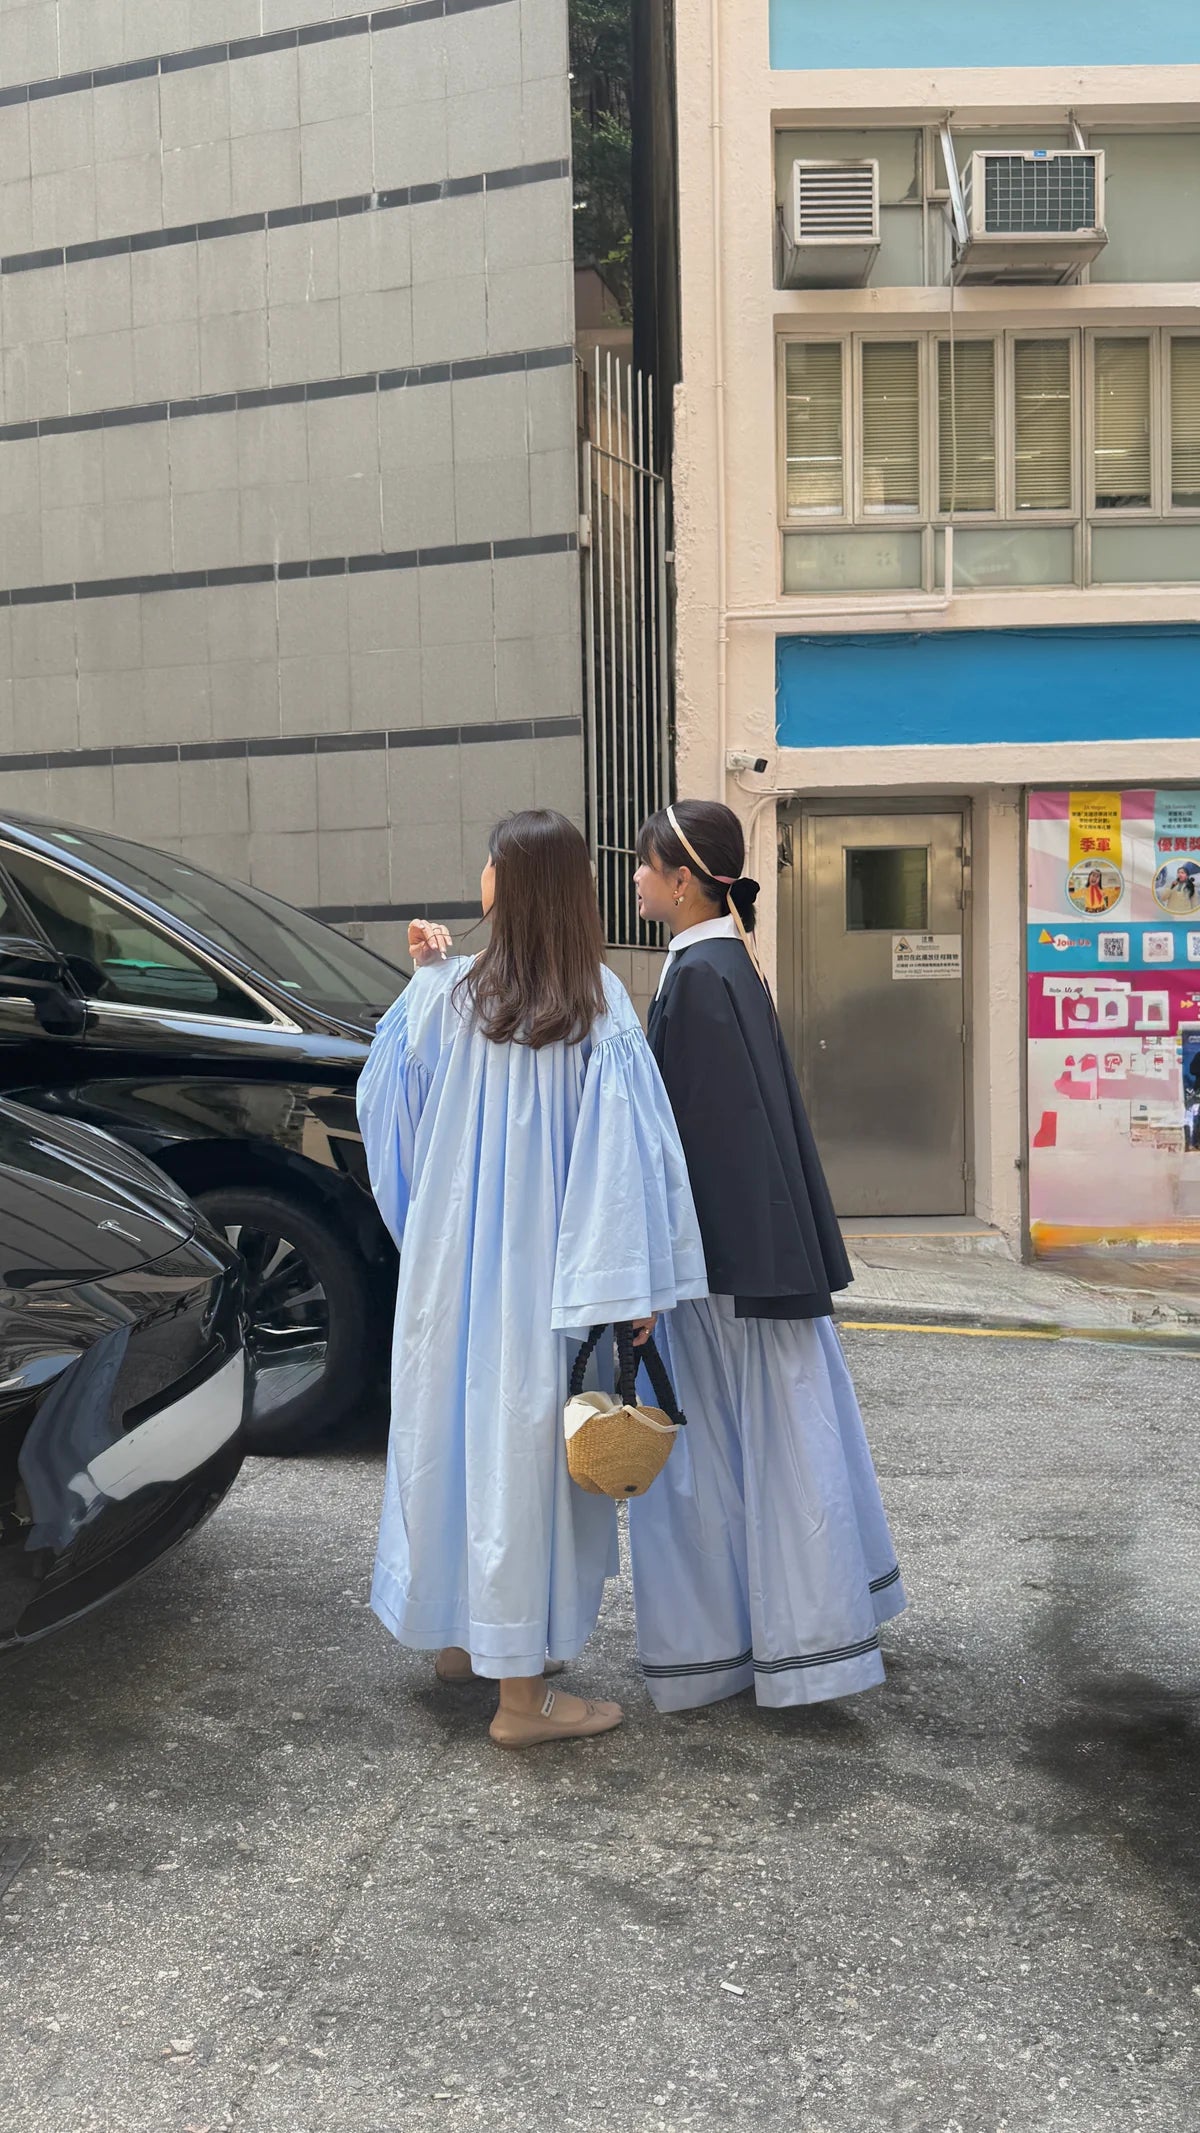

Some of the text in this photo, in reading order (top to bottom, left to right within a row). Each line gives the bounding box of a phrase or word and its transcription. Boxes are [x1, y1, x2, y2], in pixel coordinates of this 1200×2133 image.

[1079, 837, 1111, 853] 季軍
[1056, 938, 1091, 947] Join Us
